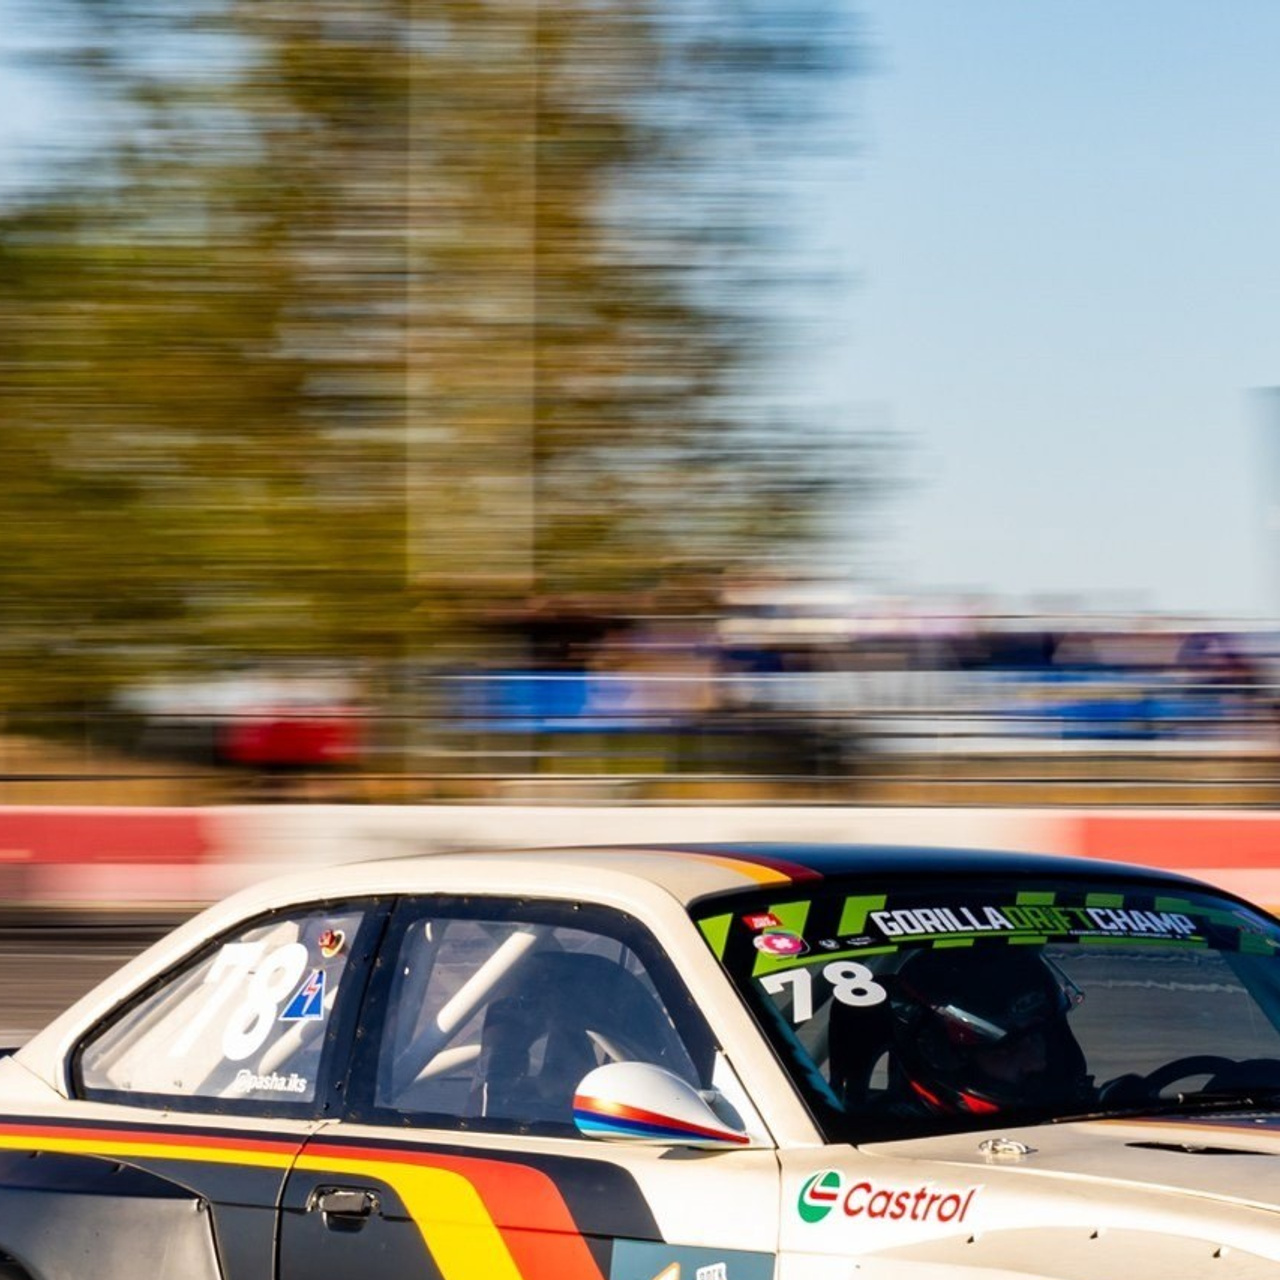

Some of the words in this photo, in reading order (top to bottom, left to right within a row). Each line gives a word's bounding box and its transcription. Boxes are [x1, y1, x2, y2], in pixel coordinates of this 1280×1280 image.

[168, 943, 308, 1061] 78
[759, 961, 887, 1023] 78
[843, 1181, 976, 1223] Castrol
